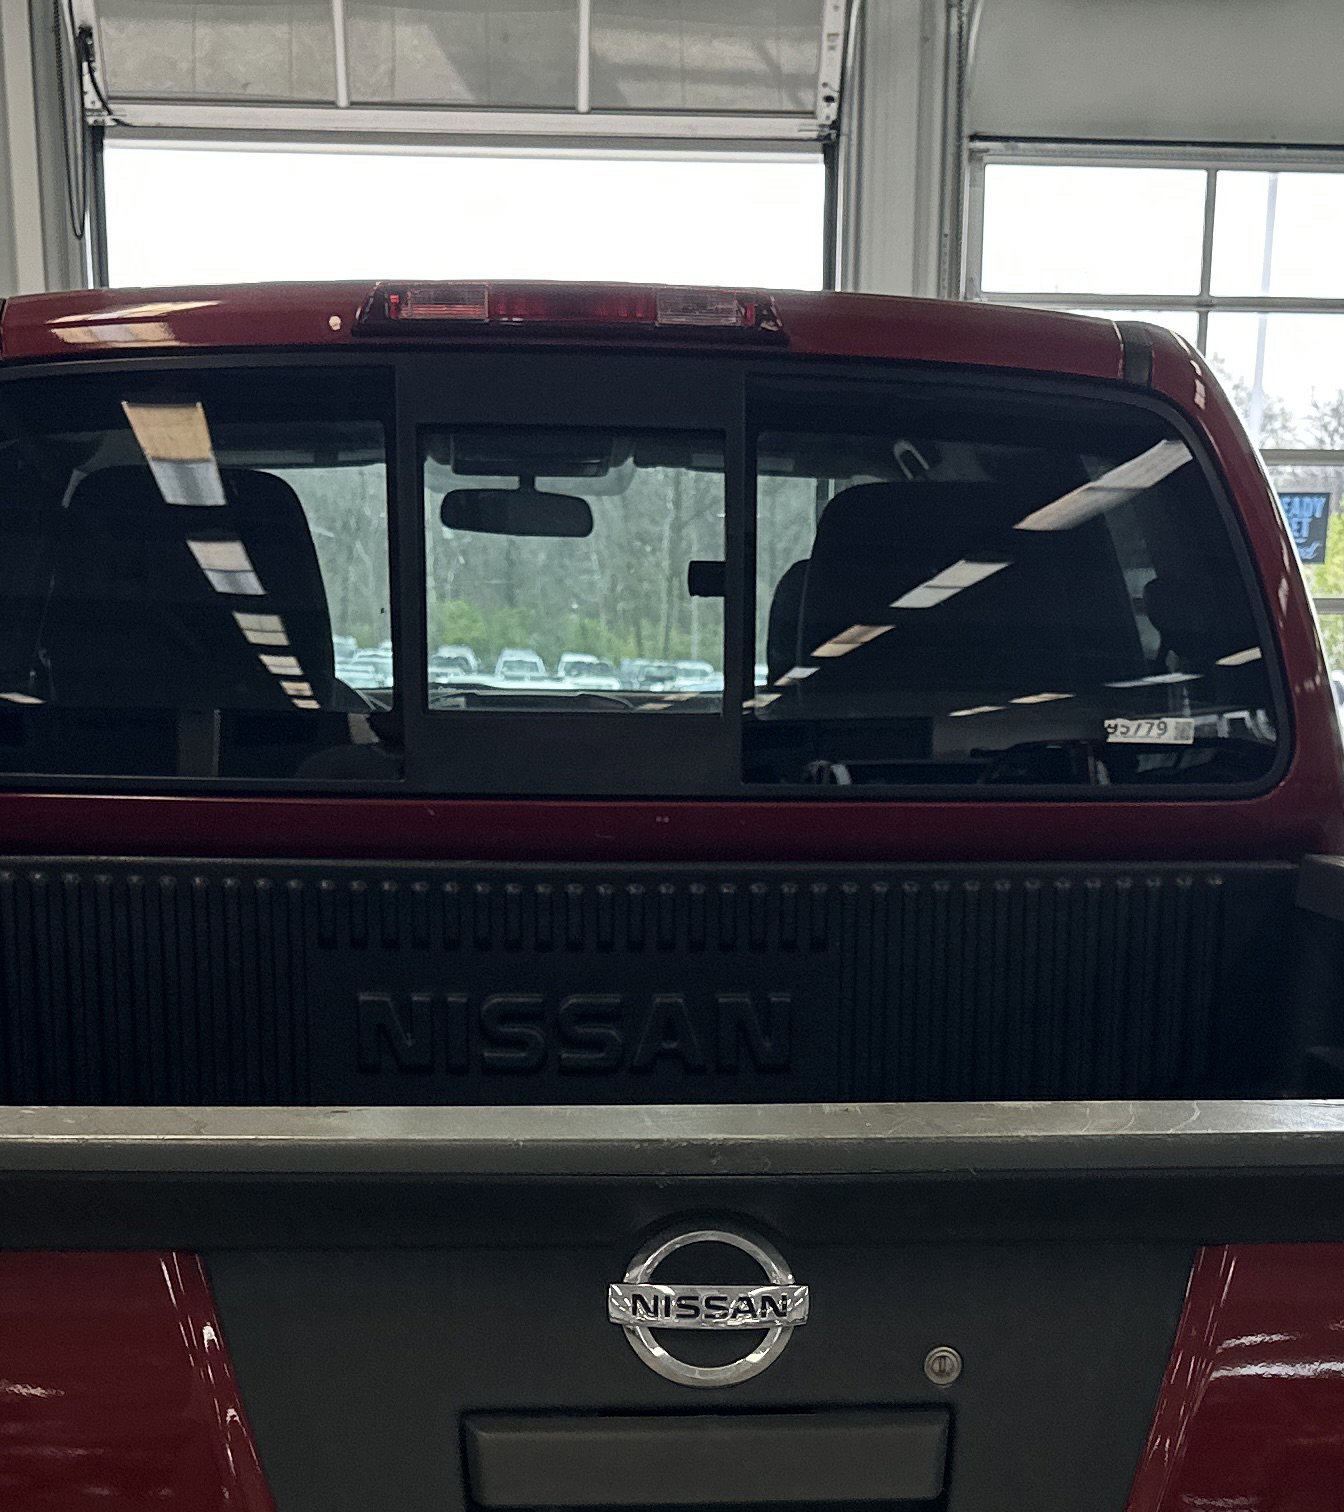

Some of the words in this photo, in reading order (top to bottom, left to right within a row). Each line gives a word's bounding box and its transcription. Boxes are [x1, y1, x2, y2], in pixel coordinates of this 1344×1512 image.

[1281, 496, 1327, 518] EADY
[1290, 517, 1314, 538] ET
[357, 992, 793, 1074] NISSAN
[631, 1293, 788, 1319] NISSAN
